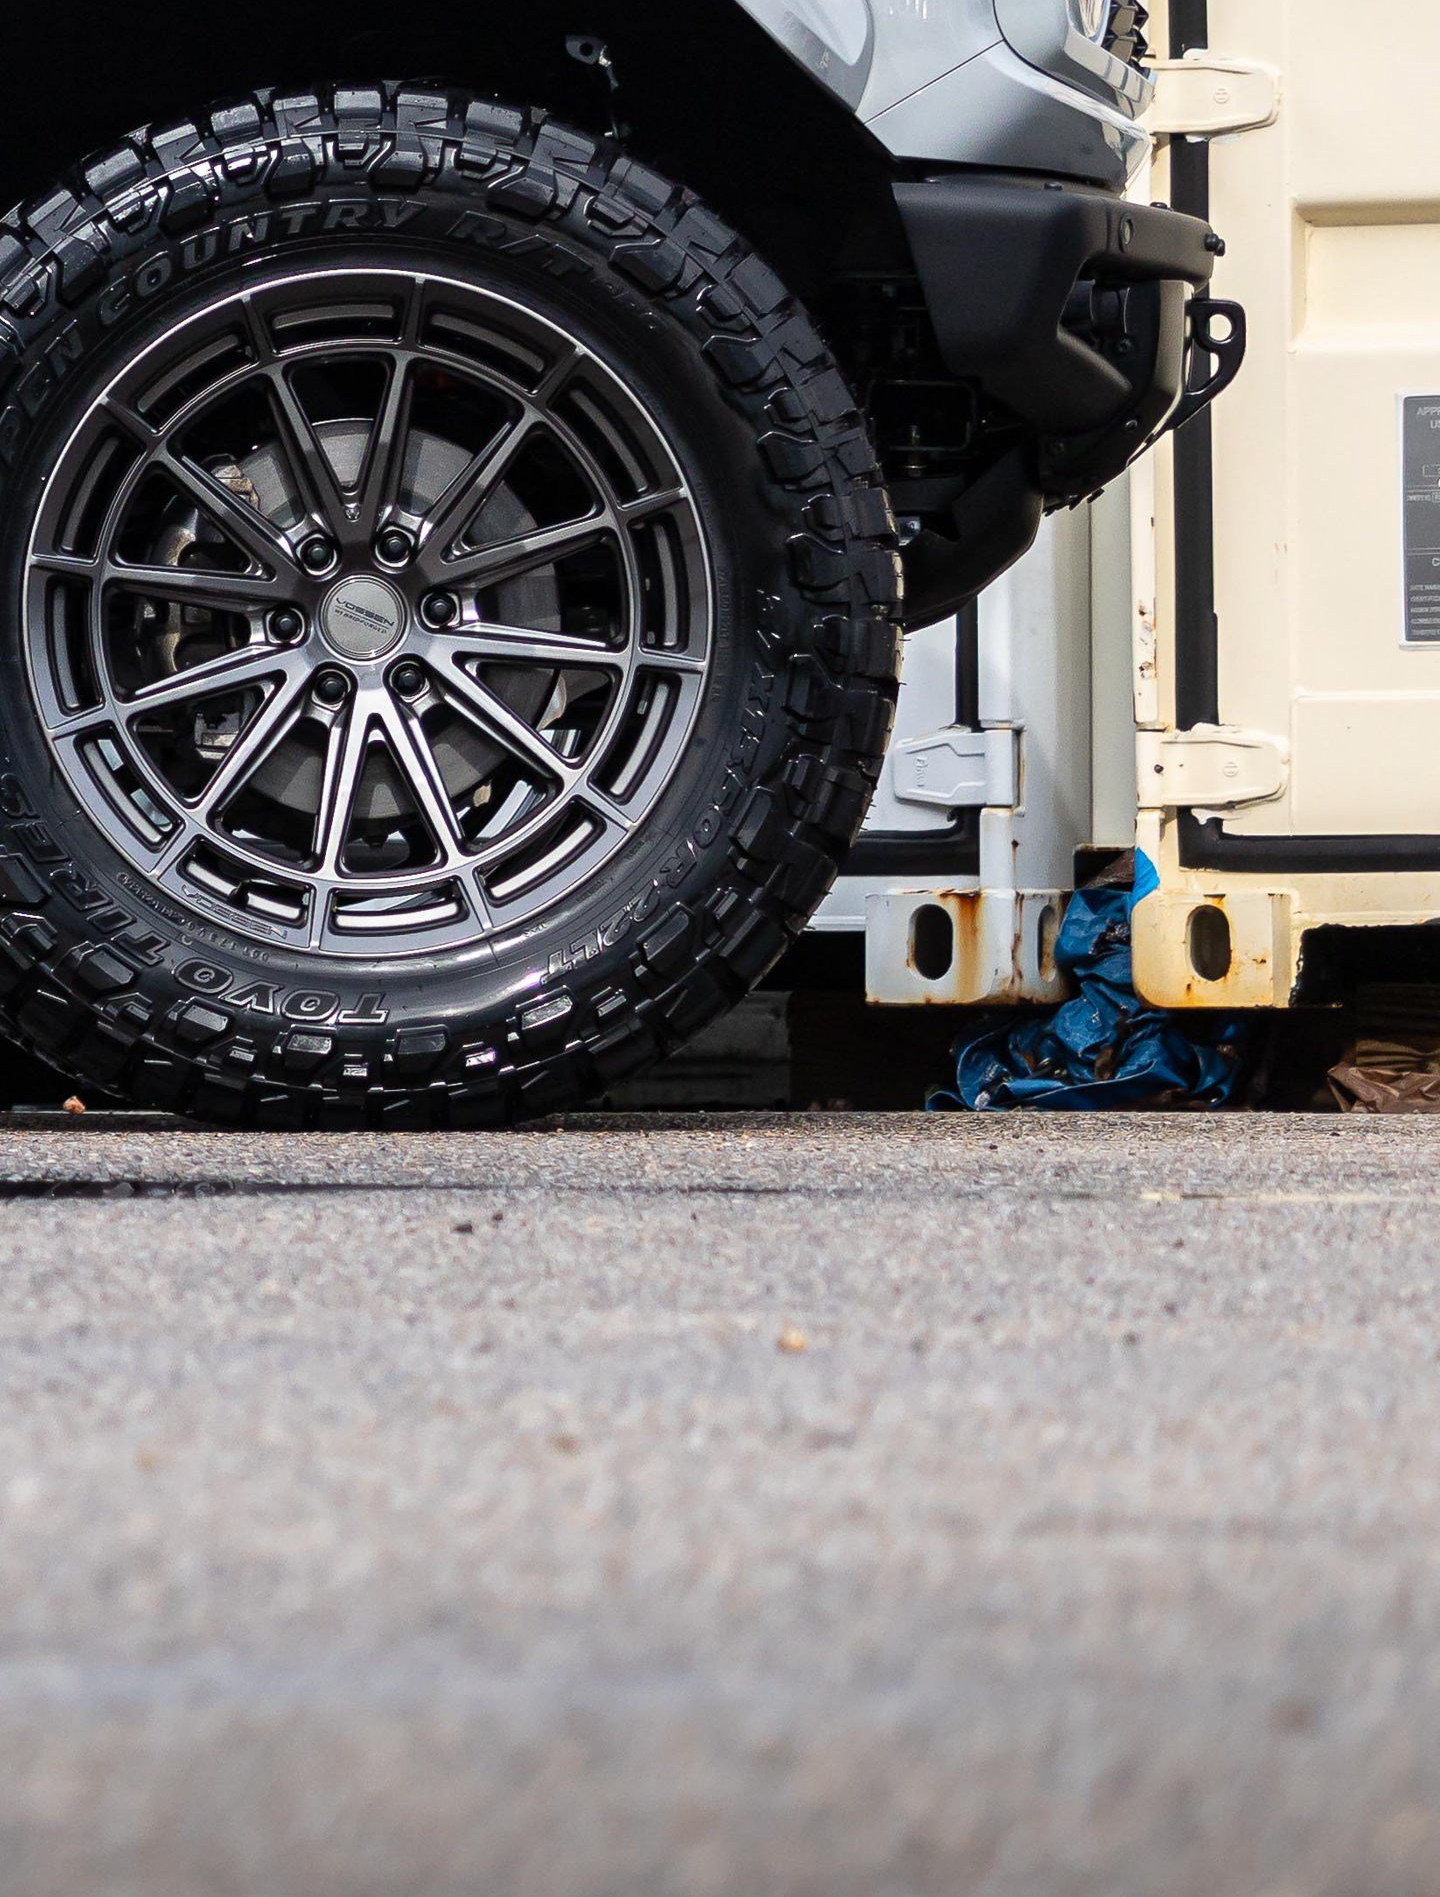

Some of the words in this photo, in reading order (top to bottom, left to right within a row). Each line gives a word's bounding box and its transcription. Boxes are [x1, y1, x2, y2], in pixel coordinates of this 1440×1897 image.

[95, 196, 430, 328] COUNTRY
[335, 597, 395, 627] VOSSEN
[171, 956, 390, 1027] TOYO
